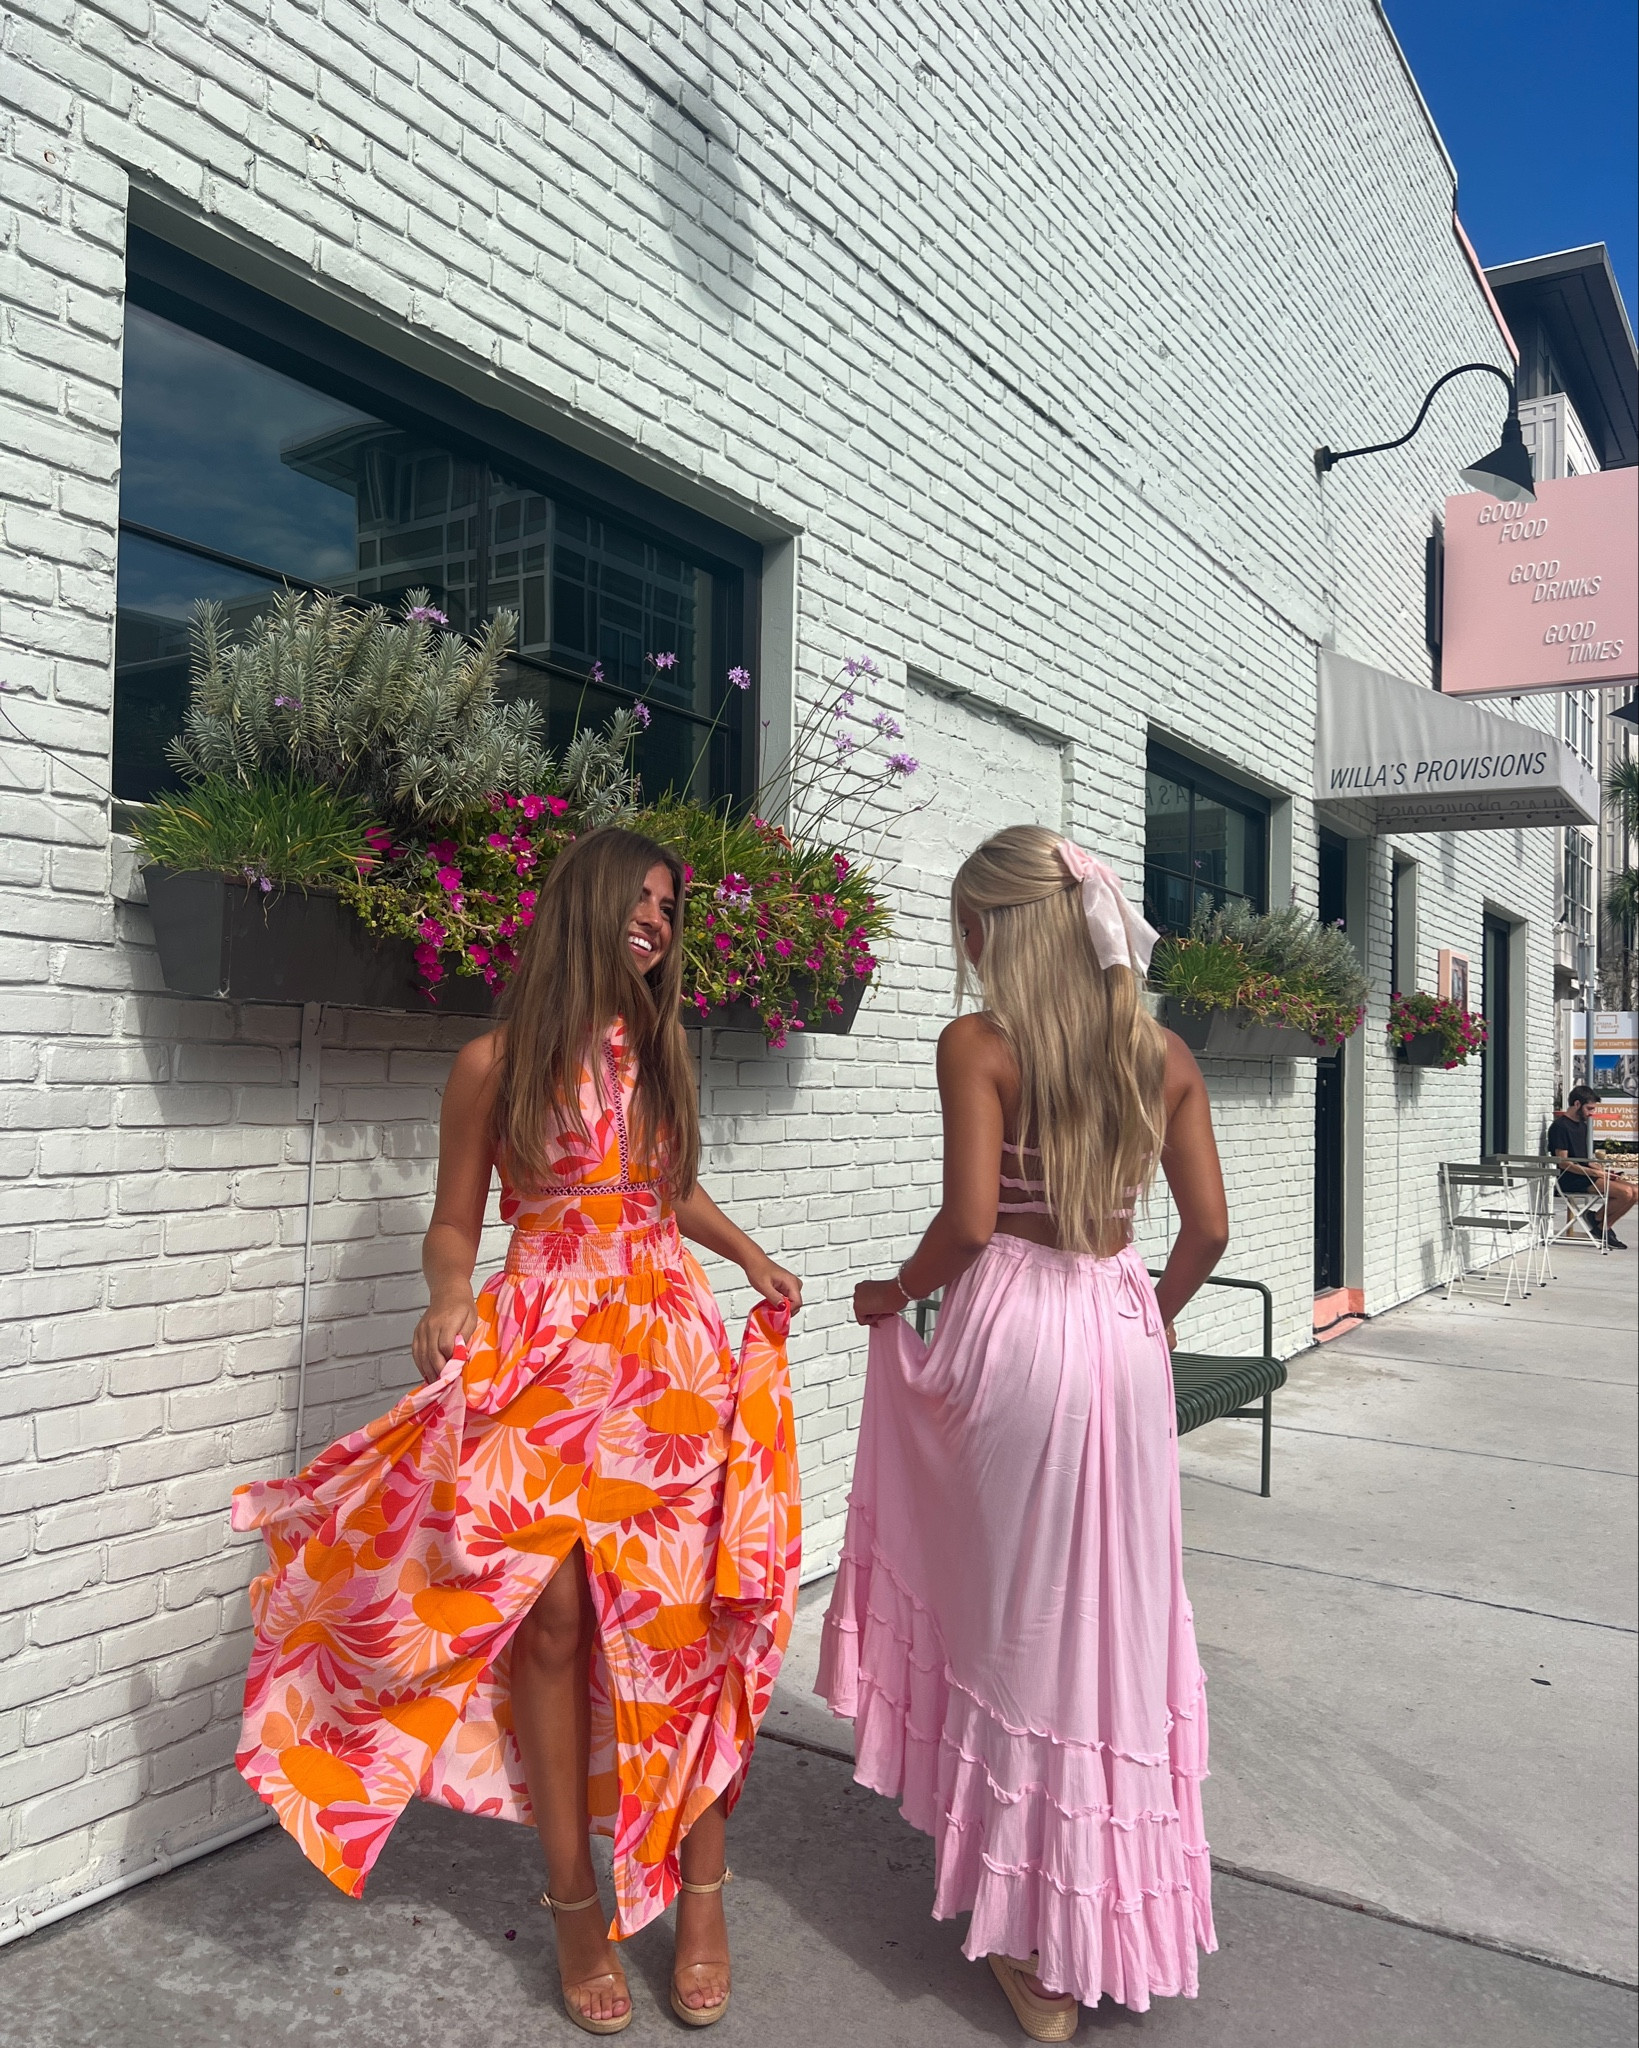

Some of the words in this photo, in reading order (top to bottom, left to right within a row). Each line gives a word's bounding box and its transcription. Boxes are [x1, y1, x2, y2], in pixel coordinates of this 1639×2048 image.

[1478, 501, 1529, 524] GOOD
[1500, 518, 1548, 543] FOOD
[1510, 560, 1560, 584] GOOD
[1533, 575, 1602, 602] DRINKS
[1544, 620, 1596, 644] GOOD
[1568, 639, 1624, 664] TIMES
[1330, 763, 1407, 789] WILLA'S
[1413, 752, 1547, 783] PROVISIONS
[1604, 1120, 1638, 1128] TODAY
